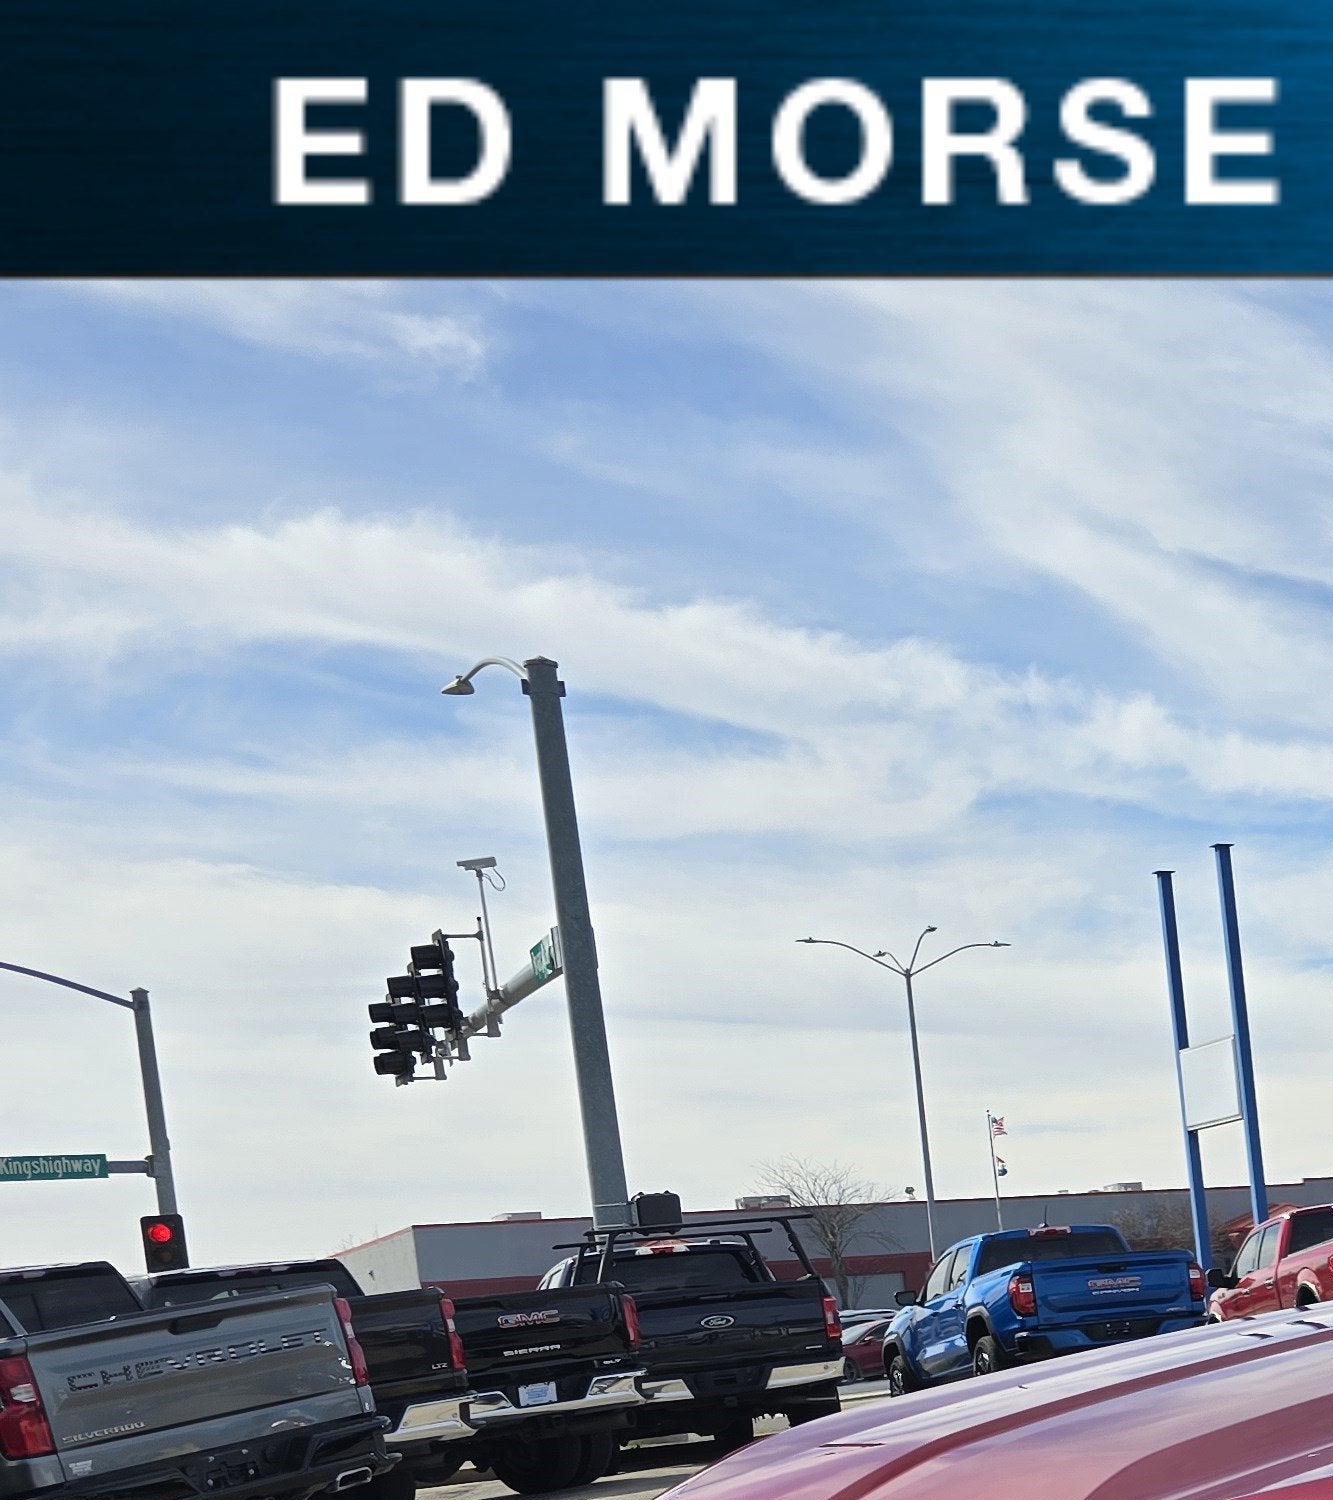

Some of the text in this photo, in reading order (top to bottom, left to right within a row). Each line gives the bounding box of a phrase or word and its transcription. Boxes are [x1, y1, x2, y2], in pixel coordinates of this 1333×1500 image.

[0, 1157, 101, 1179] Kingshighway
[497, 1309, 561, 1329] GMC
[66, 1327, 327, 1392] CHEVROLET
[502, 1344, 561, 1357] SIERRA
[62, 1421, 146, 1444] SILVERADO
